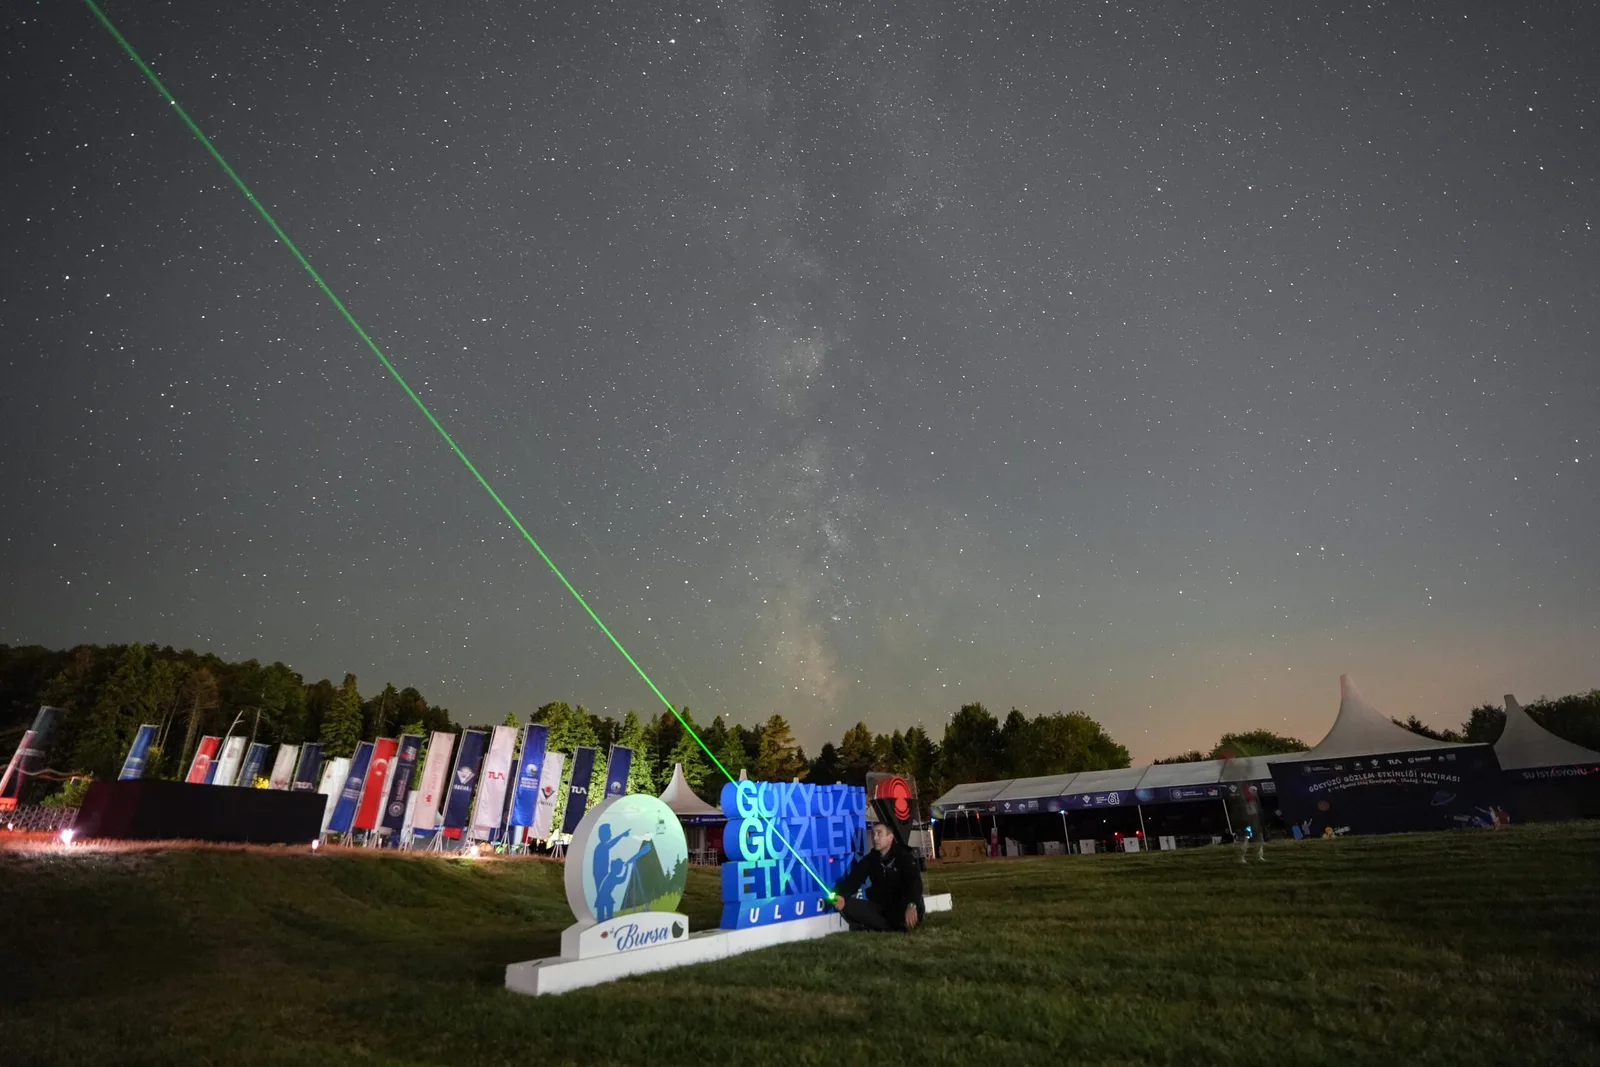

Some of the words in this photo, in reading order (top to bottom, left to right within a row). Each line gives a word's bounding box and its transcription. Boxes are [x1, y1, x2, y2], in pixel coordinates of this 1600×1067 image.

[1308, 776, 1341, 793] GÖKYÜZÜ
[1343, 771, 1375, 783] GÖZLEM
[1377, 769, 1417, 778] ETKİNLİĞİ
[1420, 771, 1461, 783] HATIRASI
[1522, 771, 1535, 780] SU
[736, 779, 866, 818] GÖKYÜZÜ
[738, 815, 866, 861] GÖZLEM
[613, 923, 669, 951] Bursa
